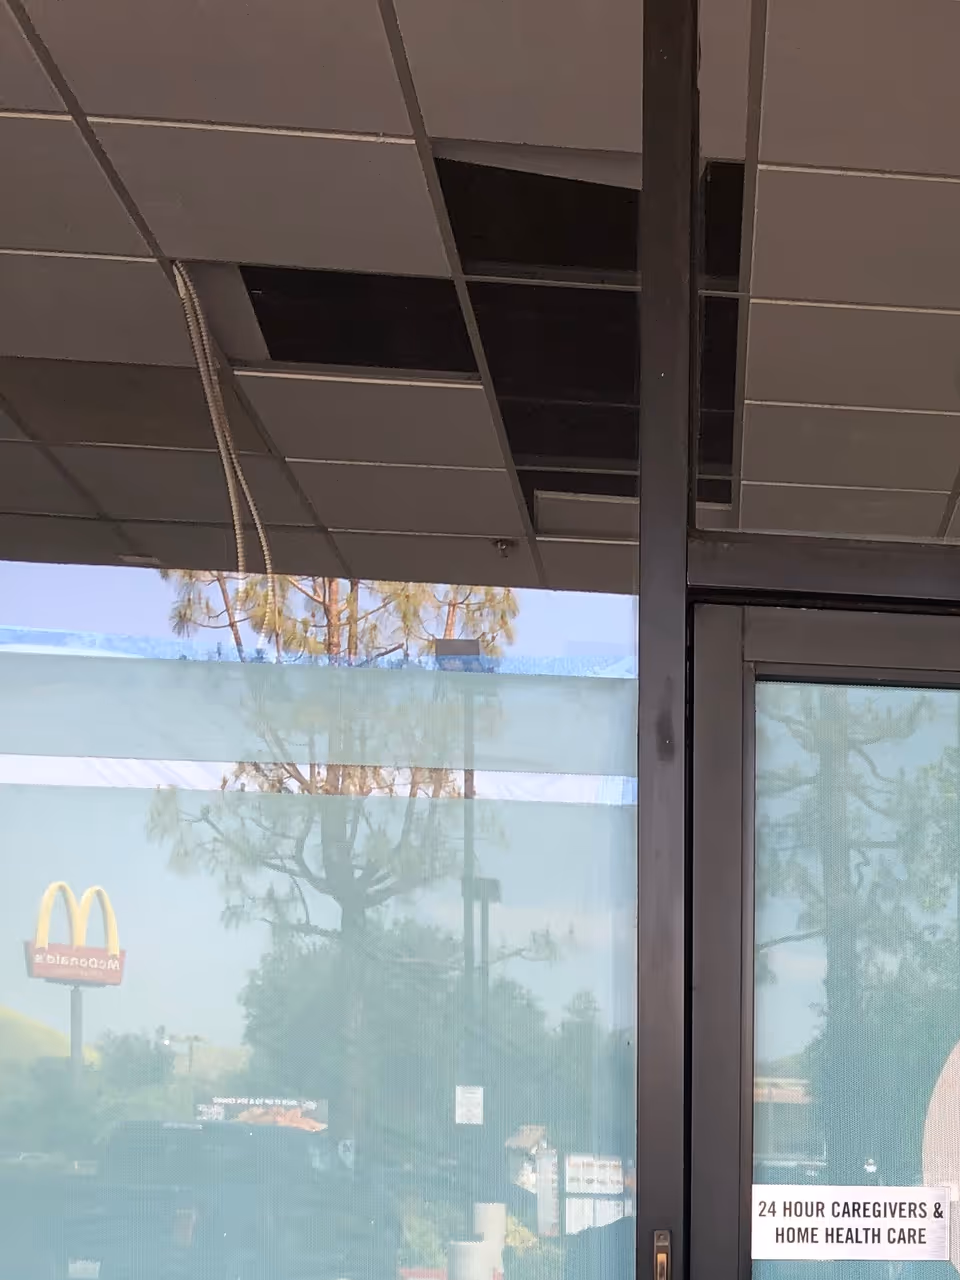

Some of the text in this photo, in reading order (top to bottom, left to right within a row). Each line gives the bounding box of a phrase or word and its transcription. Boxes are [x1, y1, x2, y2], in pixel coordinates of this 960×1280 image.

[758, 1200, 945, 1219] 24 HOUR CAREGIVERS &
[775, 1227, 927, 1244] HOME HEALTH CARE
